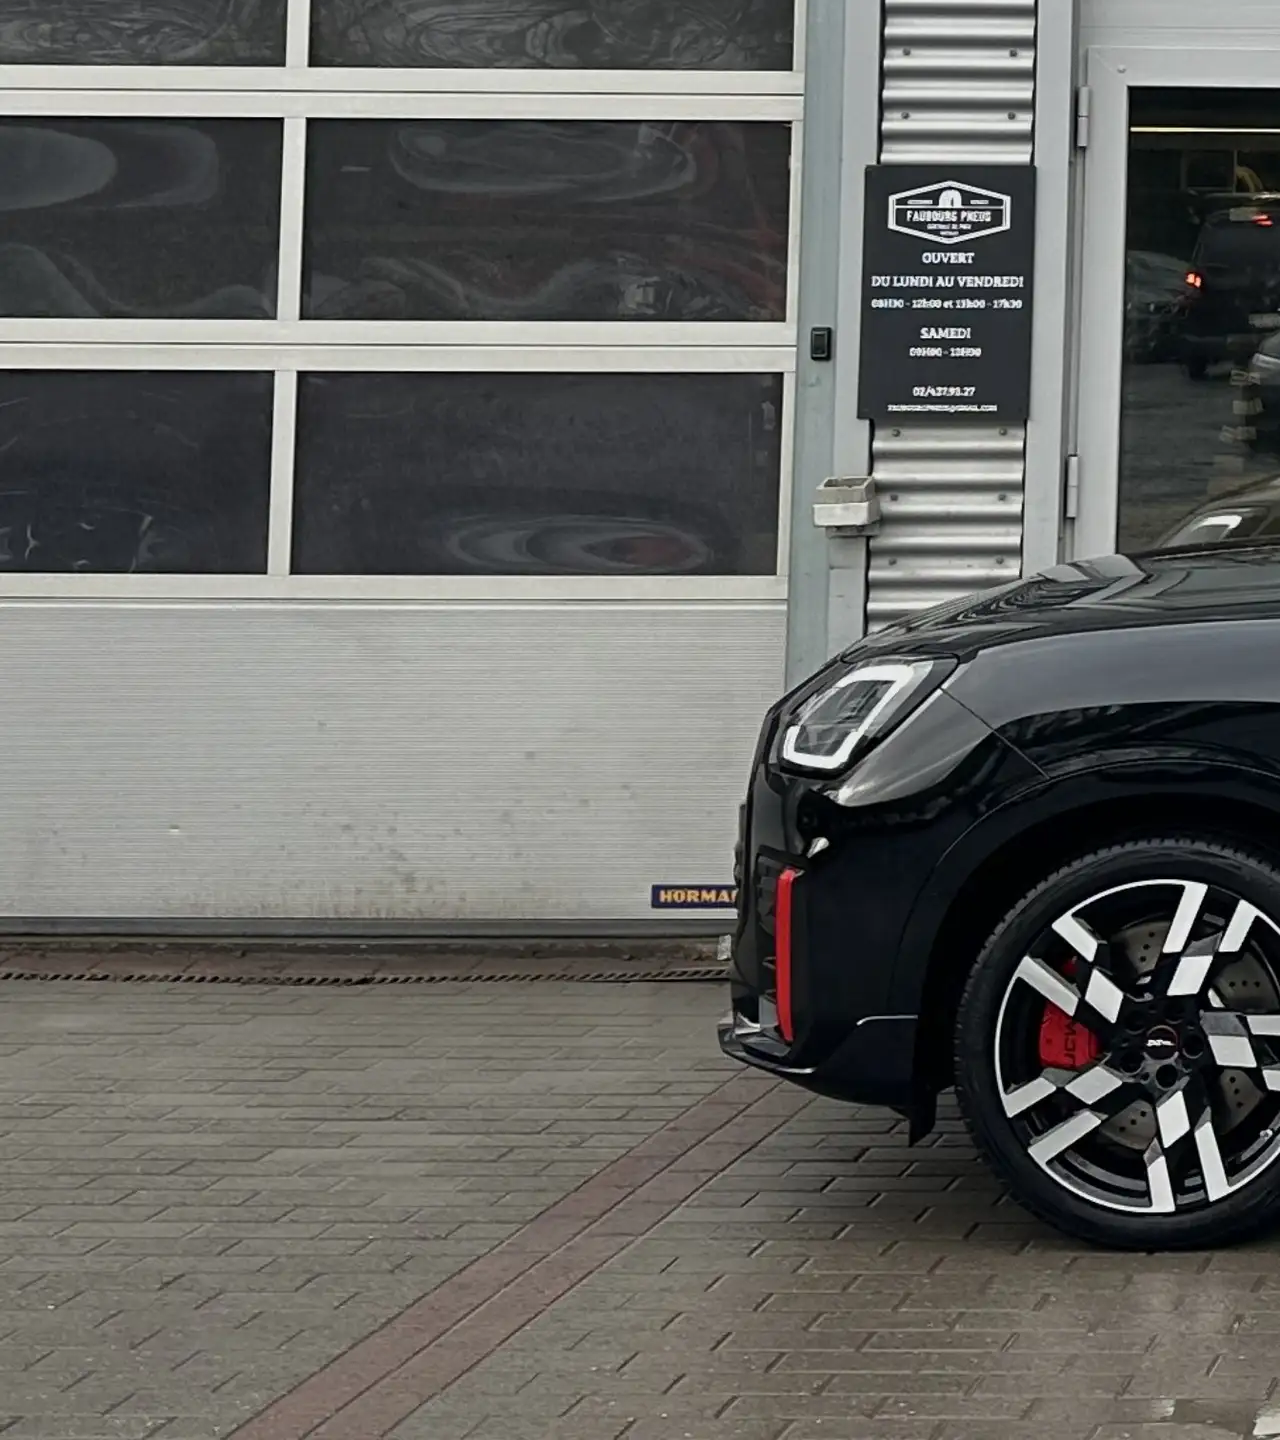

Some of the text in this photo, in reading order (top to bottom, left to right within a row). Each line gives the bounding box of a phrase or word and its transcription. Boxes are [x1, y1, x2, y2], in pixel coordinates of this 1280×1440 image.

[922, 252, 975, 264] OUVERT
[871, 275, 1024, 288] DU LUNDI AU VENDREDI
[920, 327, 971, 340] SAMEDI
